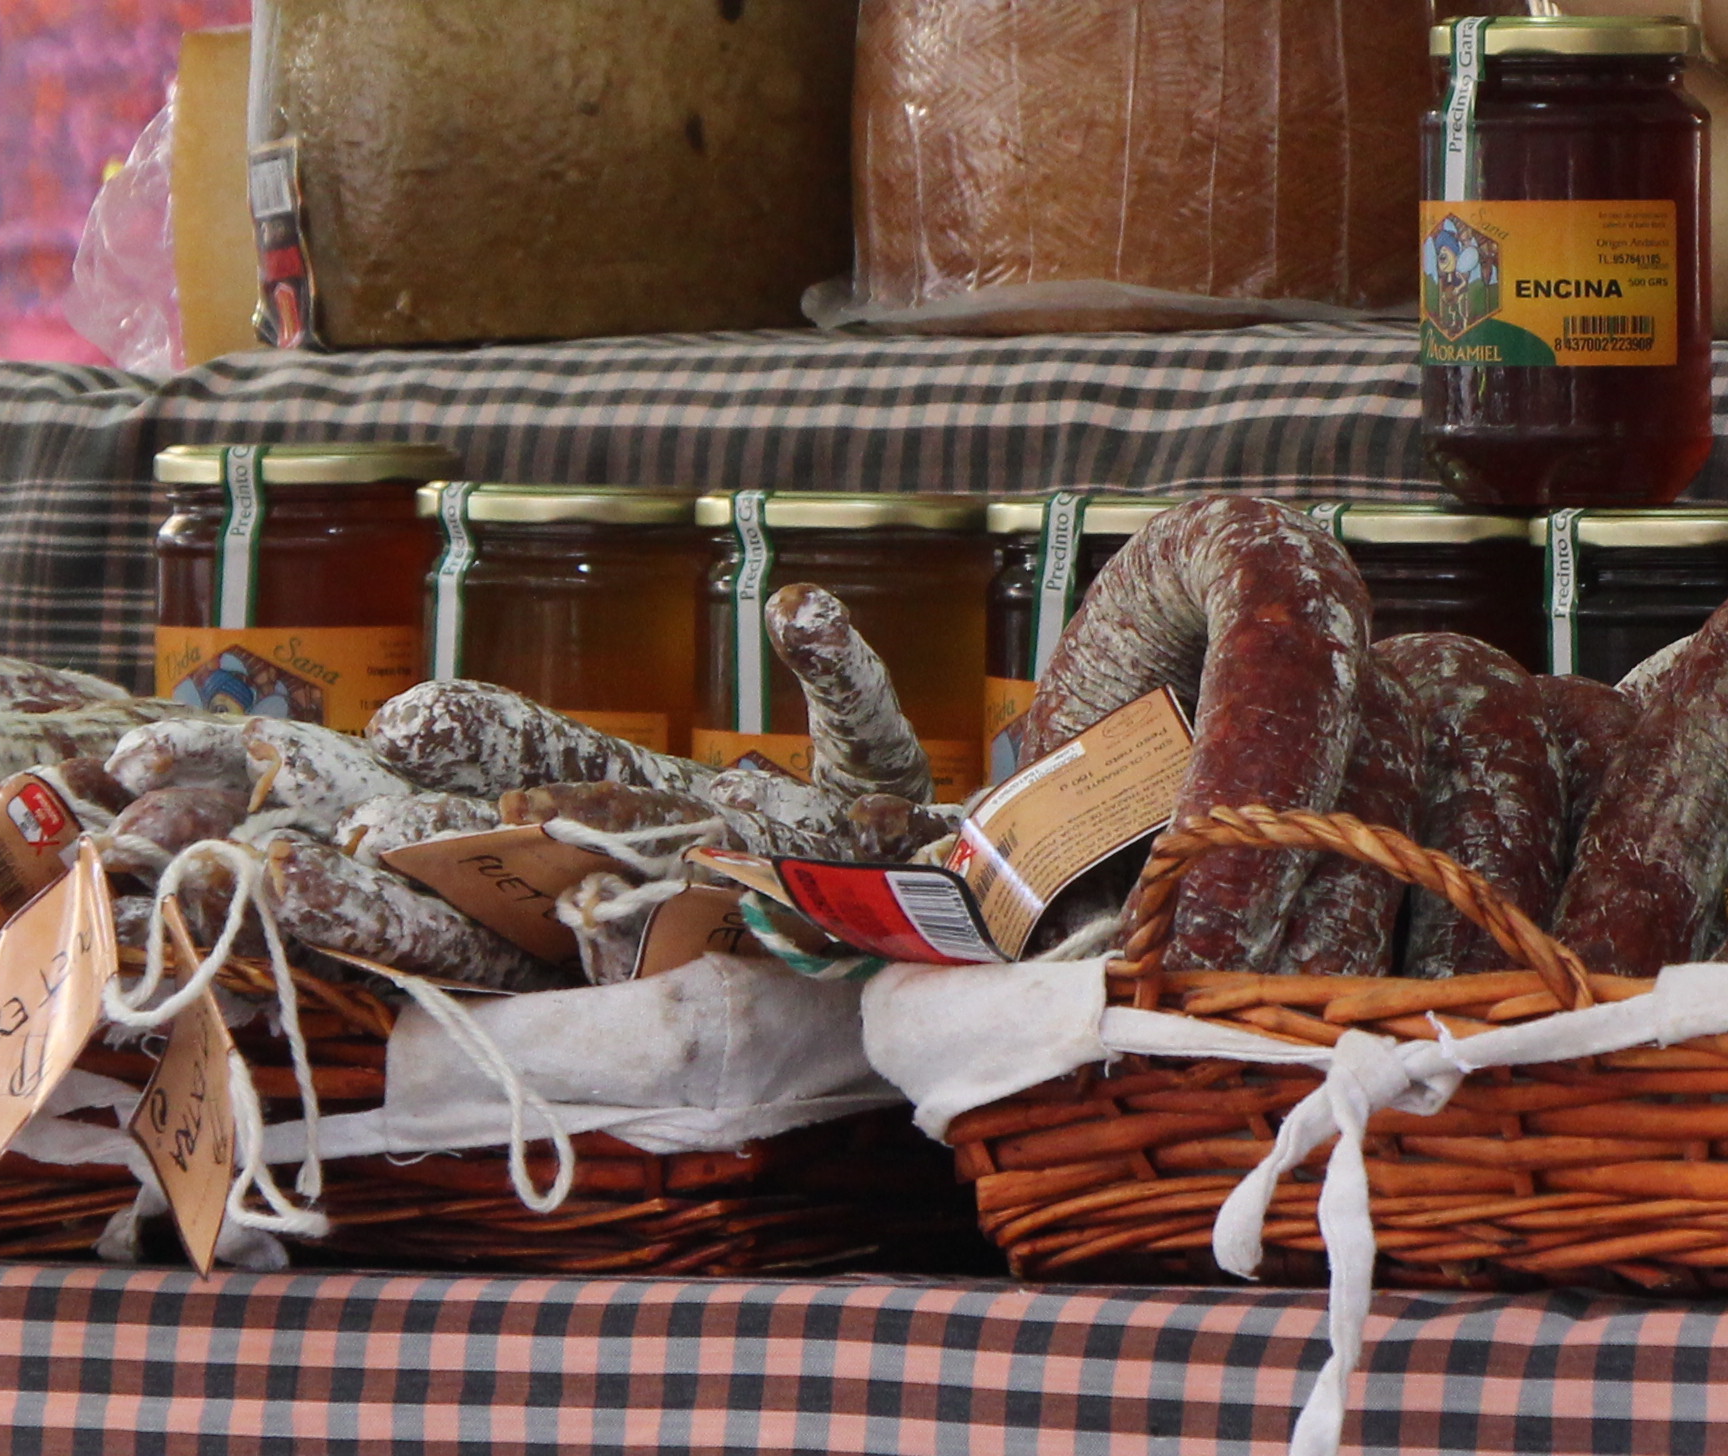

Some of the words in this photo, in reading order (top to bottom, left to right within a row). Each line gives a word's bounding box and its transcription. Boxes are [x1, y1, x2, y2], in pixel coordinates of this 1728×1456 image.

[1449, 75, 1472, 152] Precinto
[1515, 279, 1623, 299] ENCINA
[1648, 277, 1669, 286] GRS
[1425, 329, 1503, 362] MORAMIEL
[229, 464, 252, 537] Precinto
[739, 527, 763, 600] Precinto
[1045, 512, 1069, 591] Precinto
[1554, 539, 1571, 618] Precinto
[273, 636, 341, 685] Sana
[1103, 747, 1135, 769] neto
[1134, 726, 1169, 750] Peso
[458, 854, 555, 902] FUET
